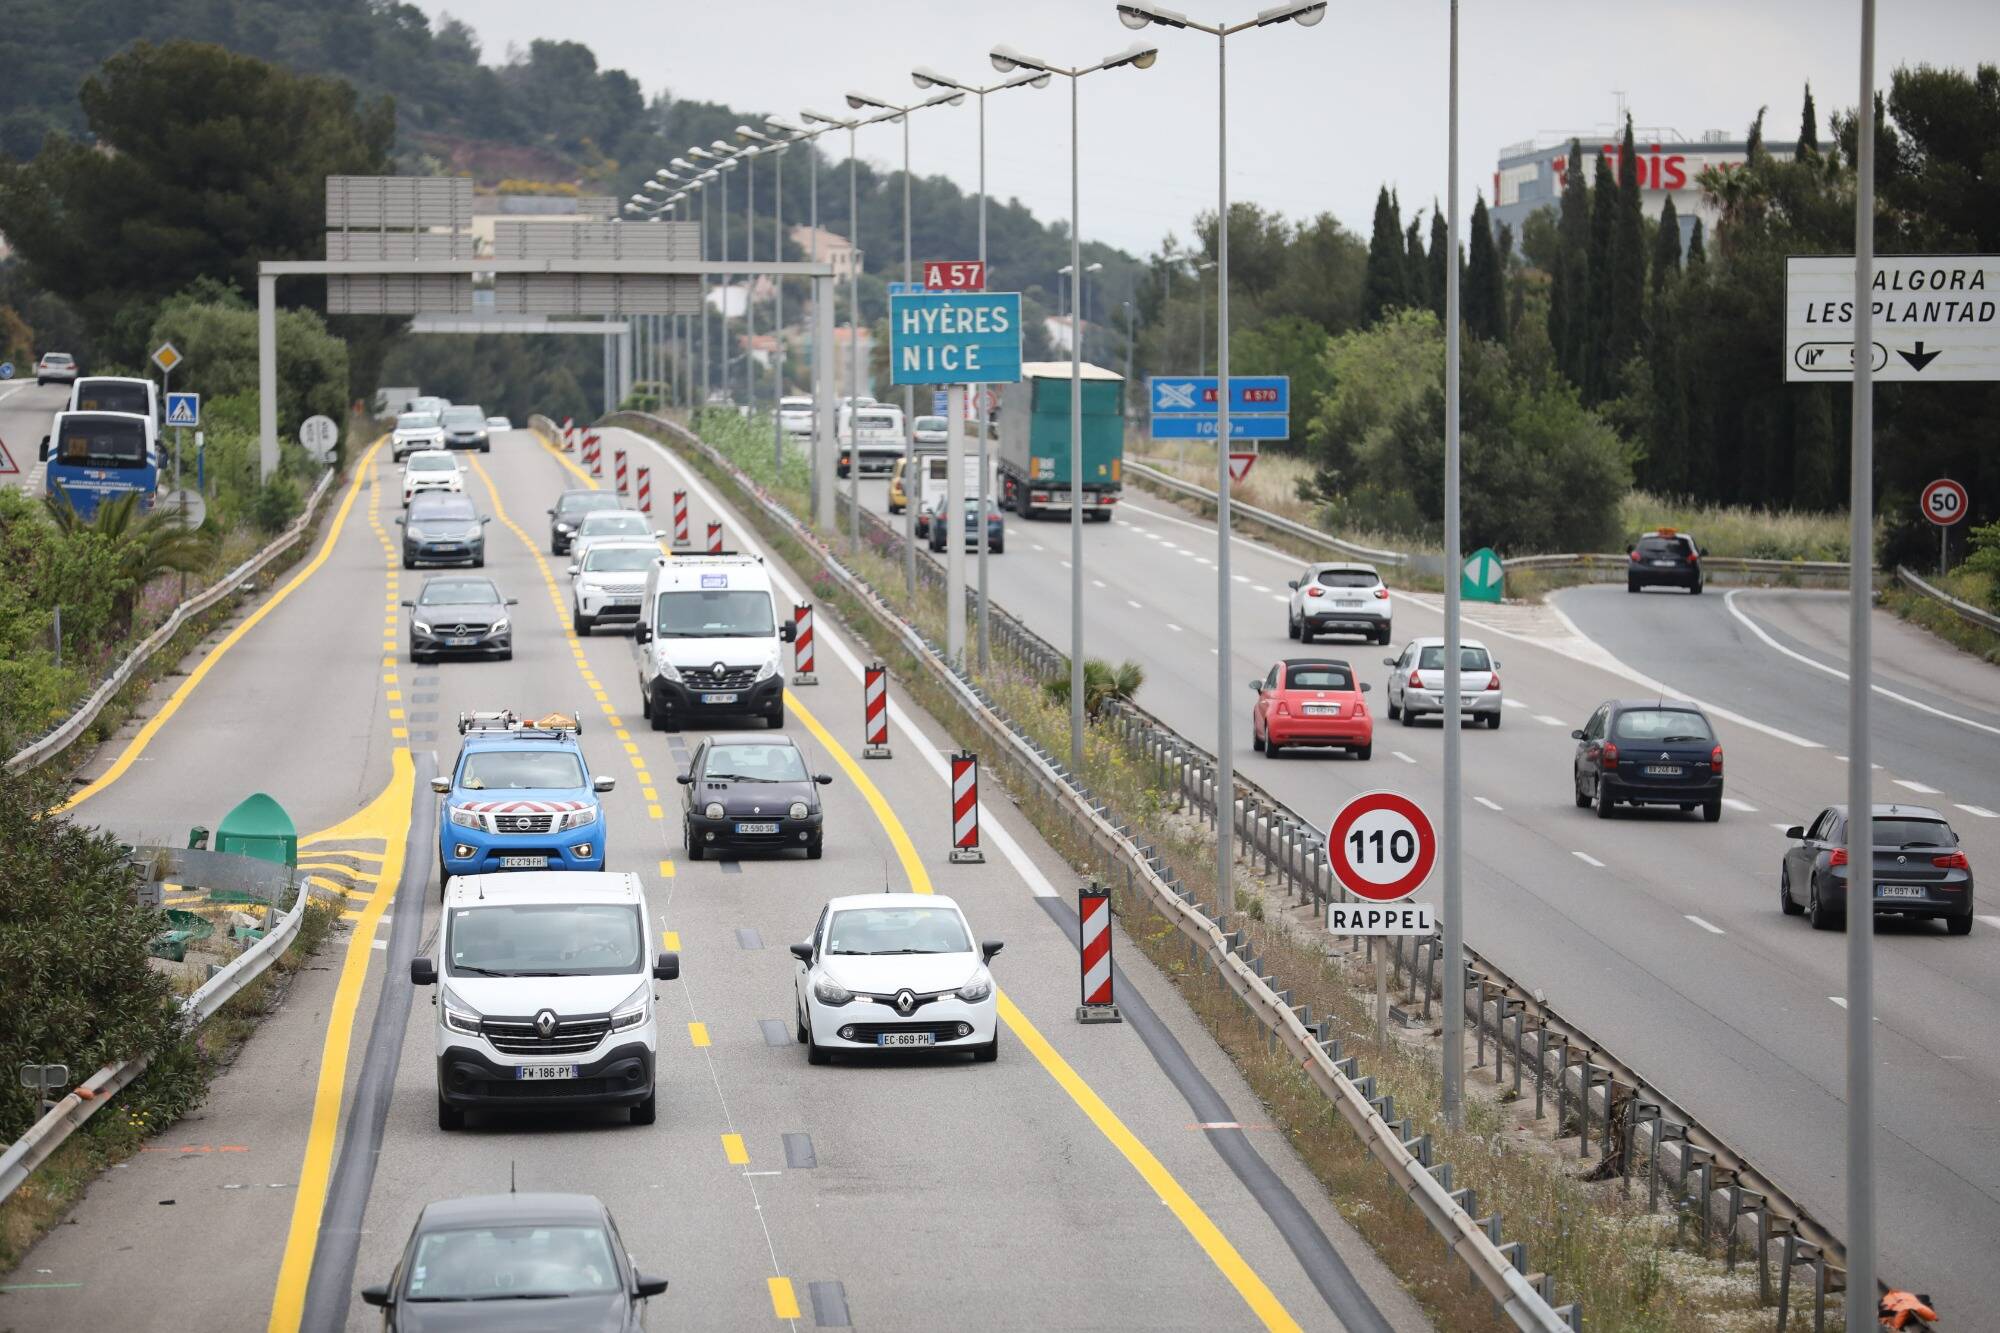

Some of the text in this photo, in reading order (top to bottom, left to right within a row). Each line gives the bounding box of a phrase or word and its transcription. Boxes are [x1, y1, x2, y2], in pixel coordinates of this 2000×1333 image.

[928, 264, 981, 287] A 57
[1871, 269, 1986, 291] ALGORA
[902, 302, 1009, 334] HYÈRES
[1806, 302, 1854, 323] LES
[903, 344, 981, 371] NICE
[1932, 493, 1958, 512] 50
[1350, 829, 1416, 864] 110
[1333, 910, 1430, 929] RAPPEL
[884, 1034, 929, 1045] EC-669-PH
[522, 1067, 571, 1078] FW-186-PY
